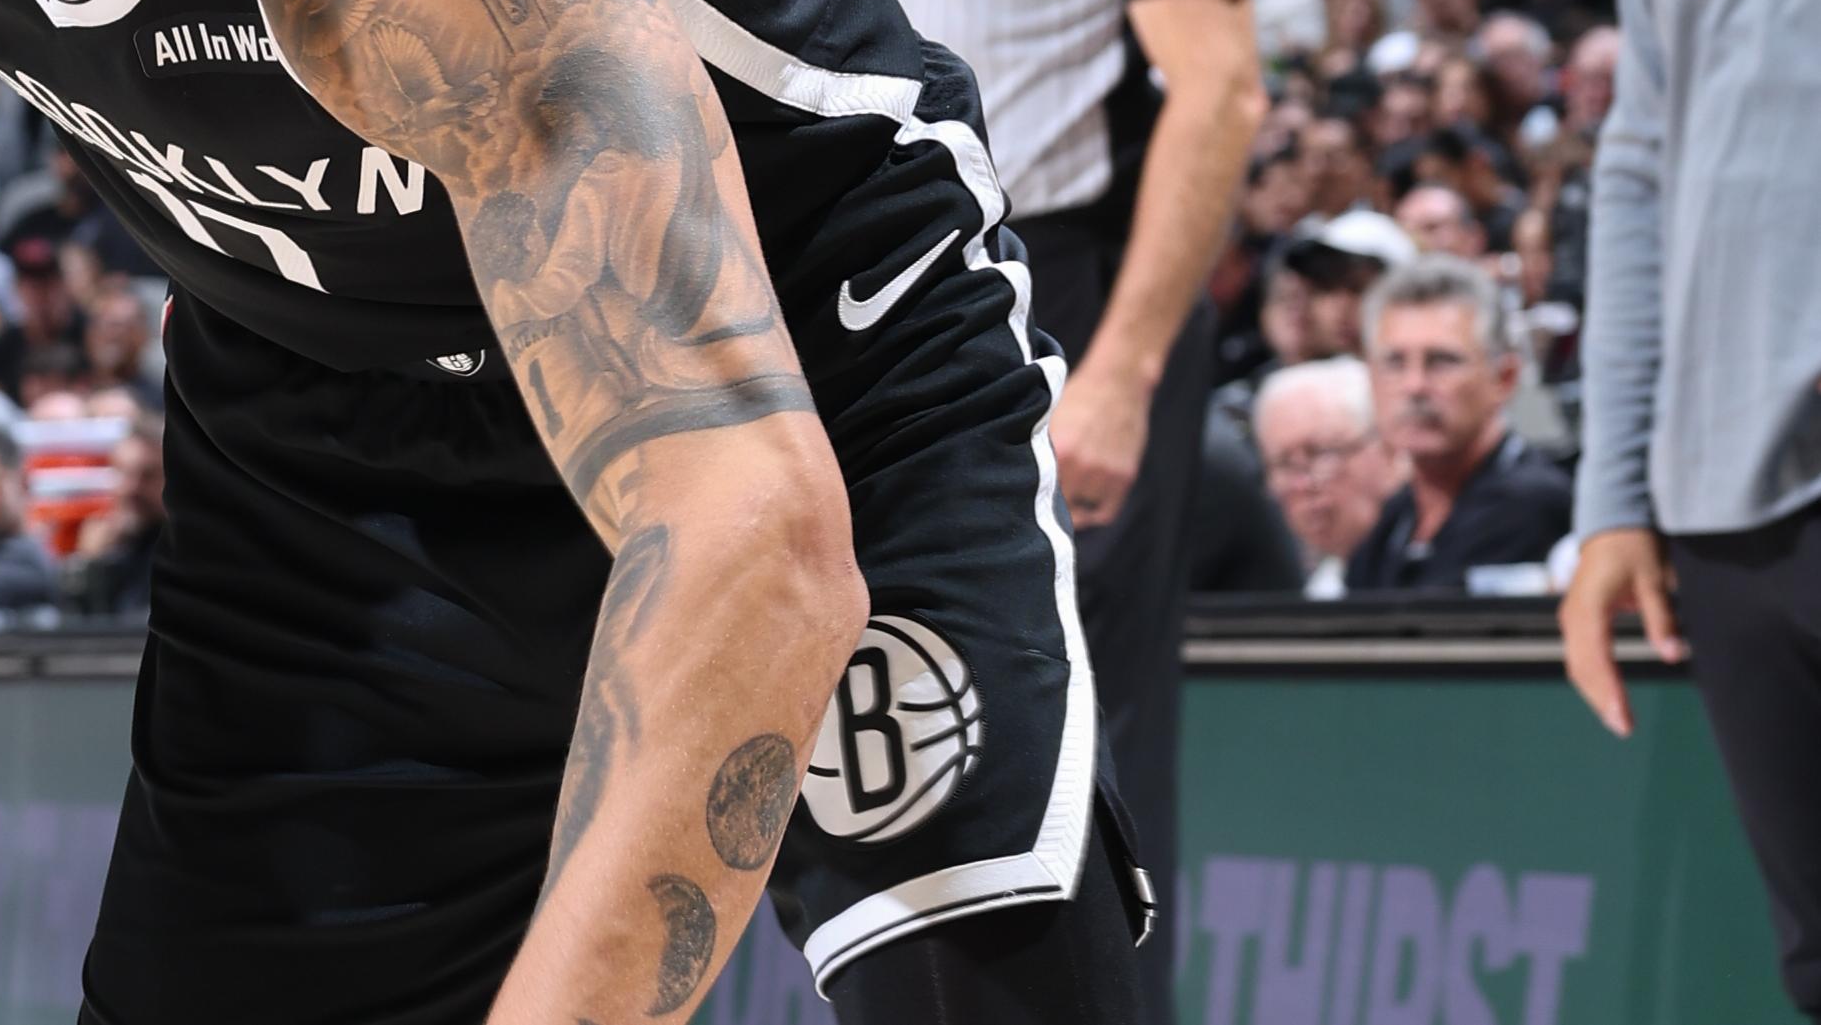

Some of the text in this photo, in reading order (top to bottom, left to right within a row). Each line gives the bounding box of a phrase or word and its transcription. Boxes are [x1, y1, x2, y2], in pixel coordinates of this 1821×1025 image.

[154, 24, 198, 67] All
[197, 22, 233, 61] In
[836, 645, 908, 814] B
